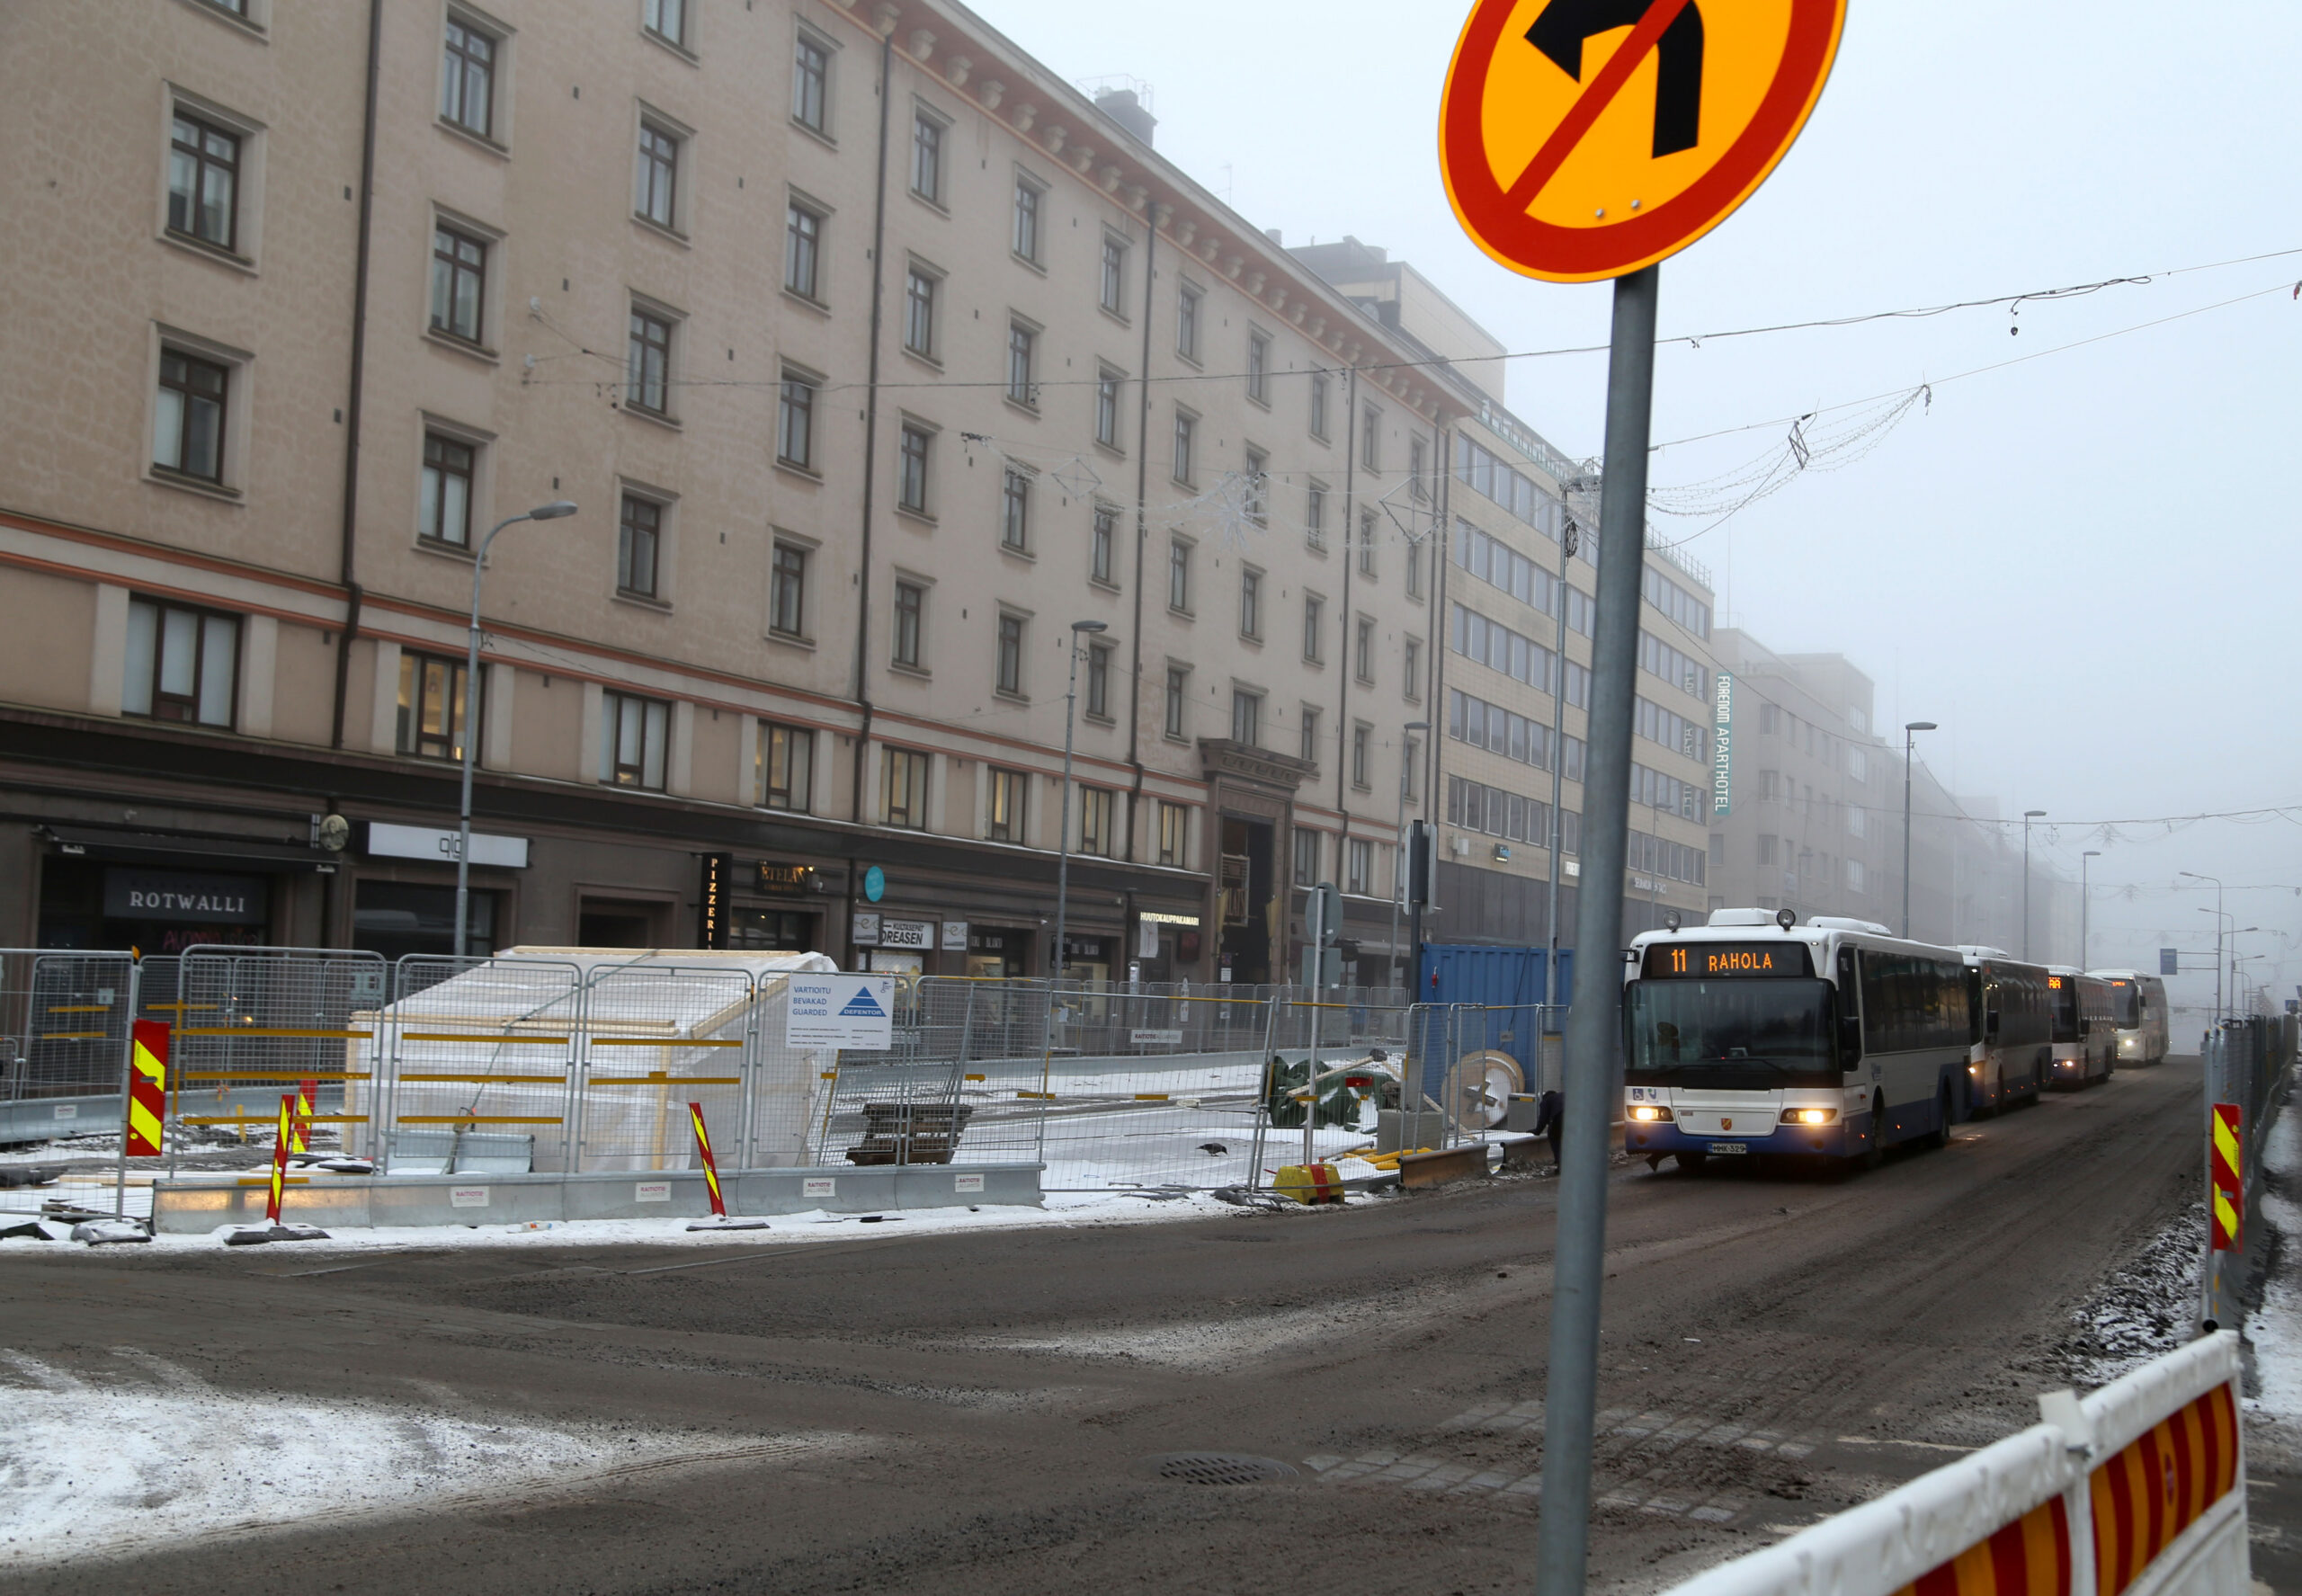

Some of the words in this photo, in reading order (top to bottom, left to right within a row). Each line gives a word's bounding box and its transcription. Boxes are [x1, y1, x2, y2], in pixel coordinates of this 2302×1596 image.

[1717, 675, 1731, 723] FORENOM
[1714, 727, 1730, 811] APARTHOTEL
[129, 891, 245, 913] ROTWALLI
[1140, 911, 1200, 926] HUUTOKAUPPAKAMARI
[882, 931, 923, 945] DREASEN
[1671, 949, 1686, 972] 11
[1709, 953, 1772, 972] RAHOLA
[793, 985, 832, 994] VARTIOITU
[793, 997, 826, 1005] BEVAKAD
[792, 1008, 827, 1016] GUARDED
